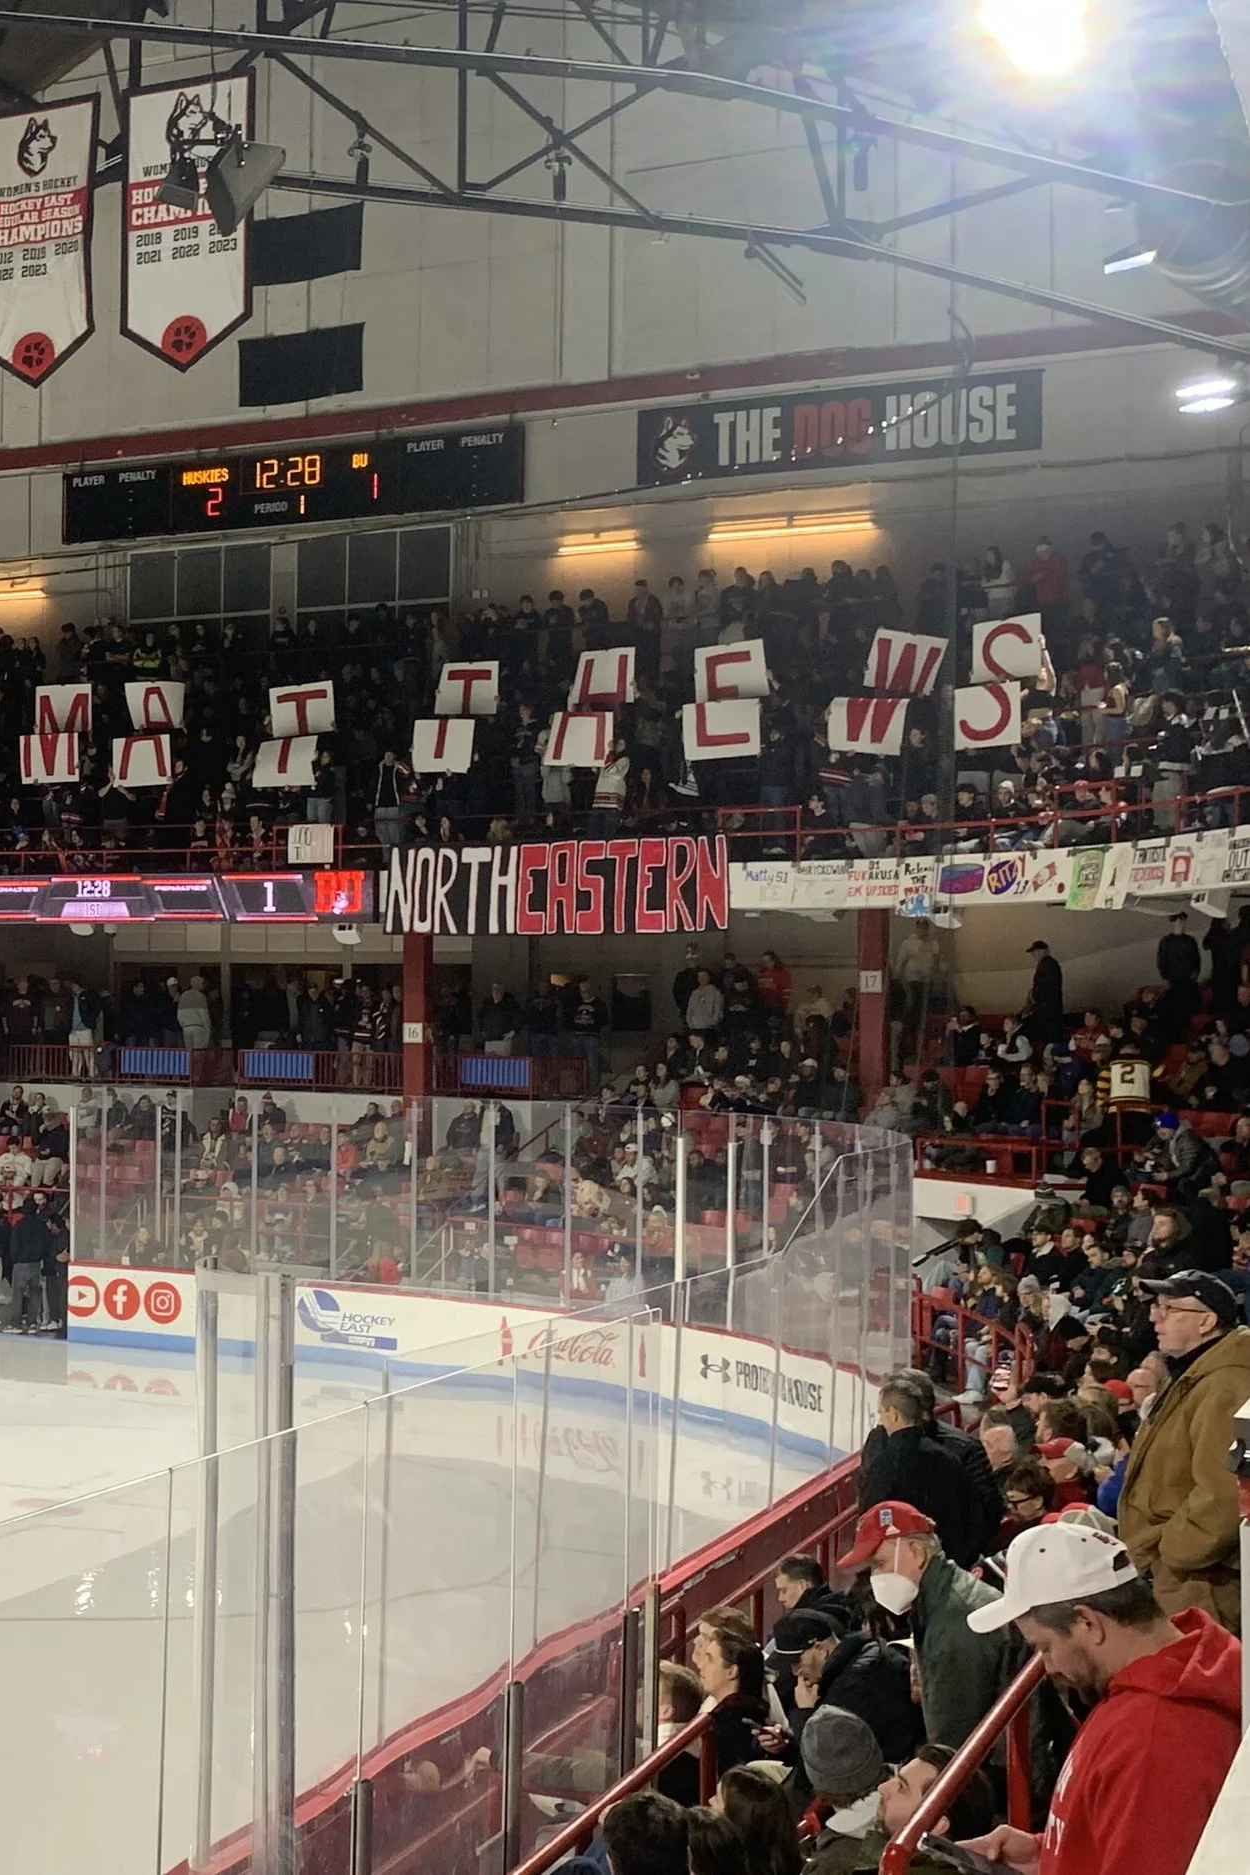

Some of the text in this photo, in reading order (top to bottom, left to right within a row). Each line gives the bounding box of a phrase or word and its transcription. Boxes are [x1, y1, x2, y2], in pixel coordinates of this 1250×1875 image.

[43, 175, 78, 190] HOCKEY
[0, 193, 73, 216] HOCKEY EAST
[41, 203, 80, 221] SEASON
[136, 231, 162, 247] 2018
[174, 226, 199, 241] 2019
[22, 246, 46, 262] 2019
[54, 240, 79, 256] 2020
[136, 238, 238, 265] 2021 2022 2023
[21, 263, 47, 278] 2023
[713, 383, 1017, 466] THE DOG HOUSE
[407, 432, 504, 454] PLAYER PENALTY
[352, 453, 368, 469] BU
[72, 469, 157, 488] PLAYER PENALTY
[182, 468, 229, 486] HUSKIES
[256, 454, 321, 489] 12:28
[372, 472, 379, 499] 1
[206, 488, 222, 516] 2
[254, 501, 288, 514] PERIOD
[299, 495, 306, 514] 1
[745, 867, 774, 884] Matty
[76, 880, 111, 898] 12:28
[263, 881, 276, 912] 1
[314, 871, 365, 912] BU
[865, 975, 878, 988] 17
[408, 1027, 419, 1039] 16
[1121, 1063, 1134, 1084] 2
[340, 1322, 372, 1333] EAST
[342, 1312, 396, 1326] HOCKEY
